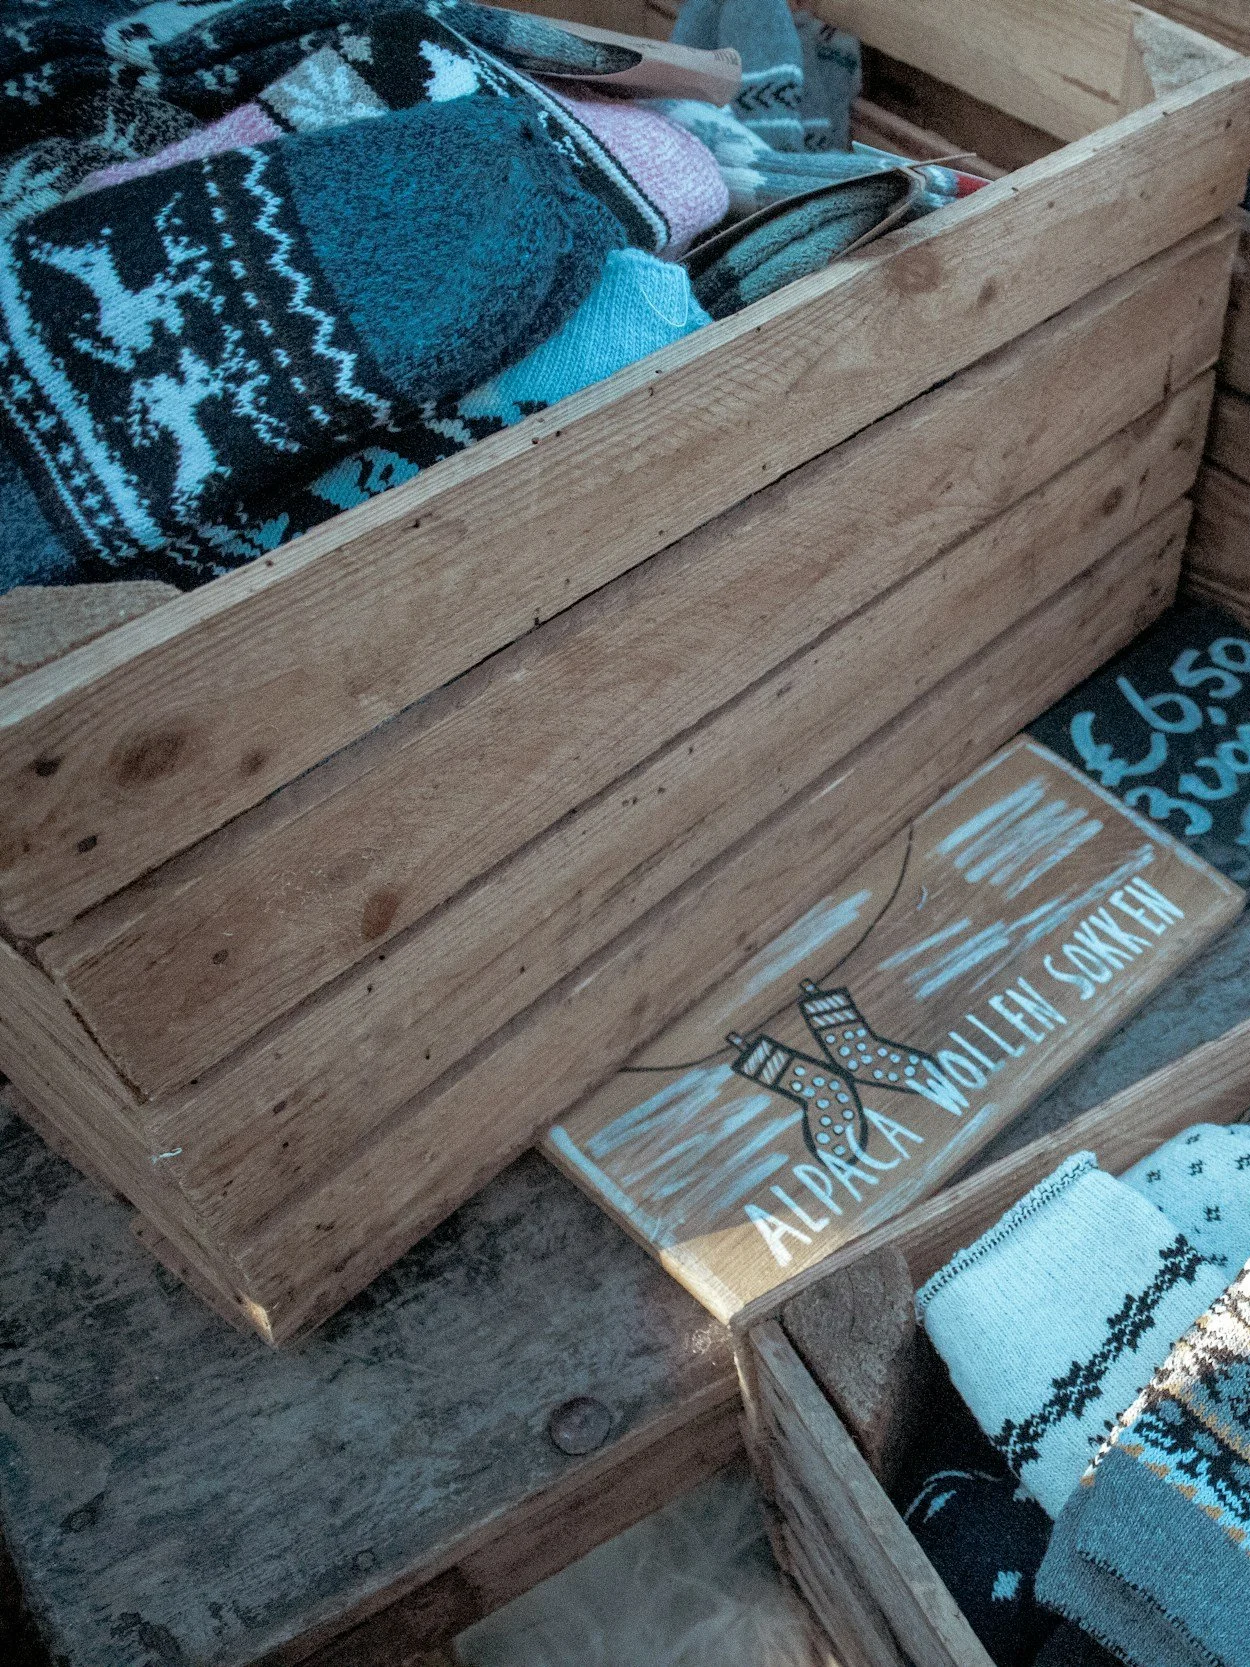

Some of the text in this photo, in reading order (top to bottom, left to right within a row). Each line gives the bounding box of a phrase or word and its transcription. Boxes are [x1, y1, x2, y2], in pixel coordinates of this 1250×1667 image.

[744, 875, 1185, 1267] ALPACA WOLLEN SOKKEN
